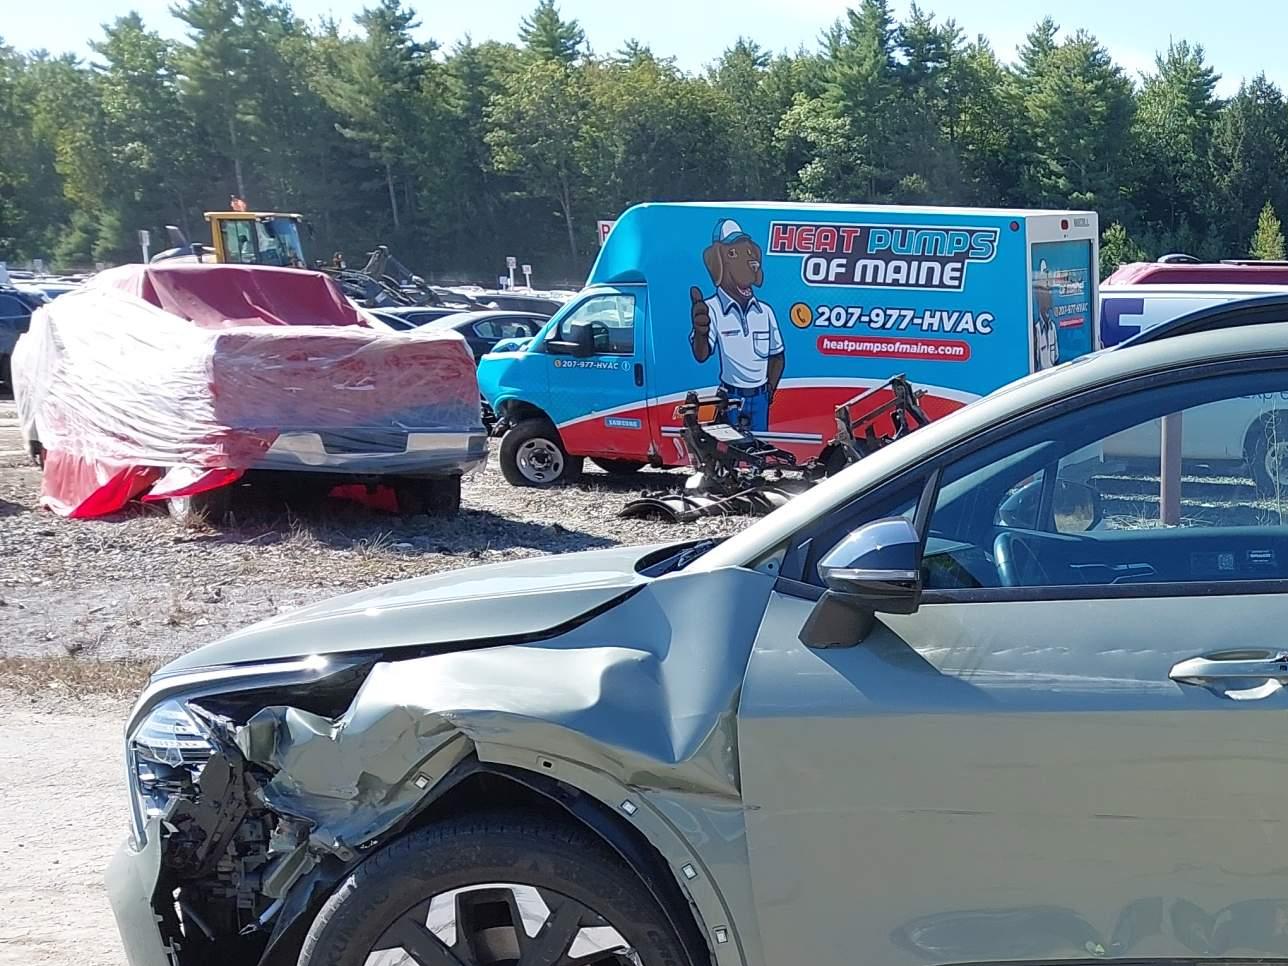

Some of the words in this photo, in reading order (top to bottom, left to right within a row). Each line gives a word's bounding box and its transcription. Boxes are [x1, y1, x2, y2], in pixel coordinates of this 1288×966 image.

[771, 225, 861, 254] HEAT
[867, 228, 995, 258] PUMPS
[805, 257, 847, 282] OF
[853, 259, 964, 286] MAINE
[814, 305, 995, 335] 207-977-HVAC
[822, 338, 965, 357] heatpumpsofmaine.com
